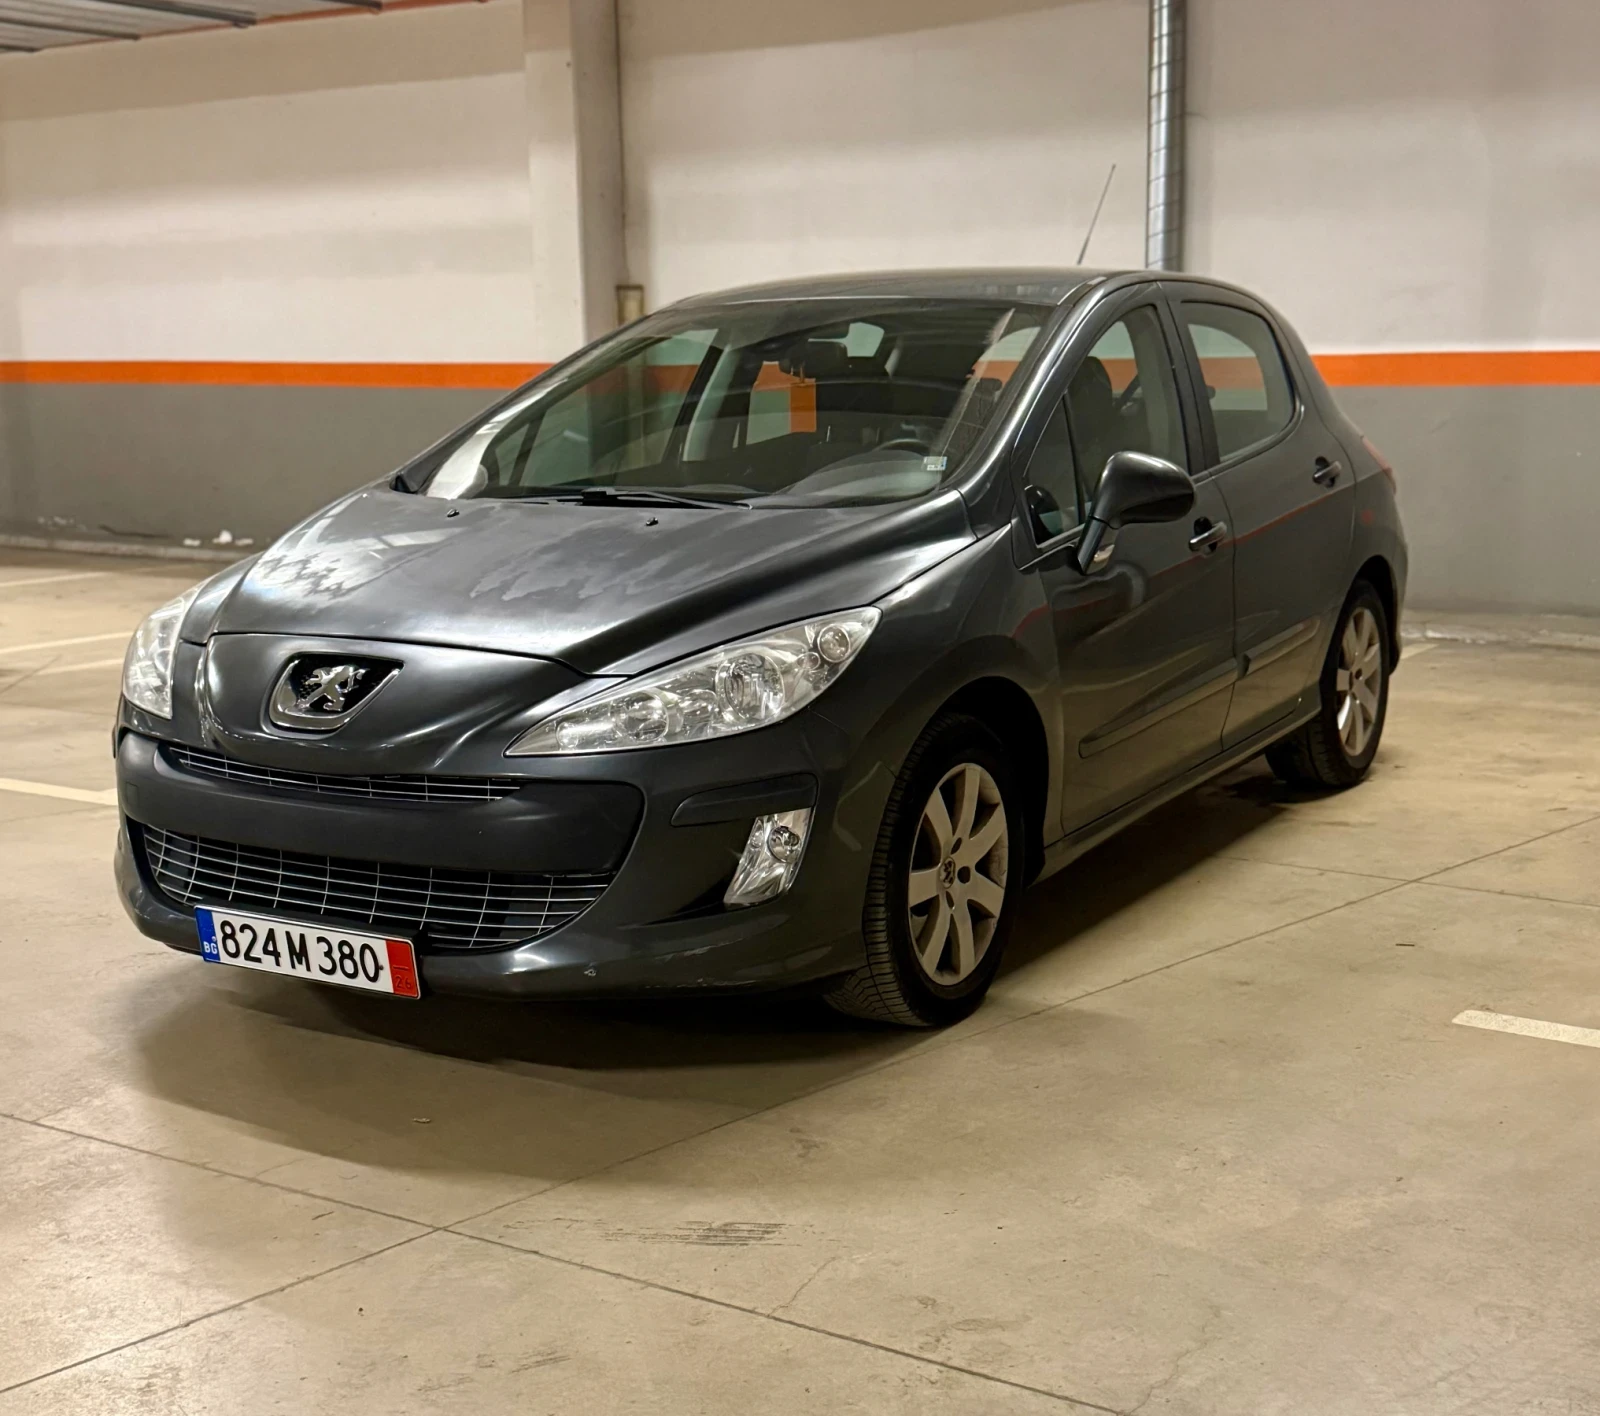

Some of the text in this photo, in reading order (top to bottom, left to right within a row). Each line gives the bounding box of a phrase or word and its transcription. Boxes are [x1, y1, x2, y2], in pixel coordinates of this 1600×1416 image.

[203, 941, 218, 955] BG
[220, 920, 380, 983] 824 M 380
